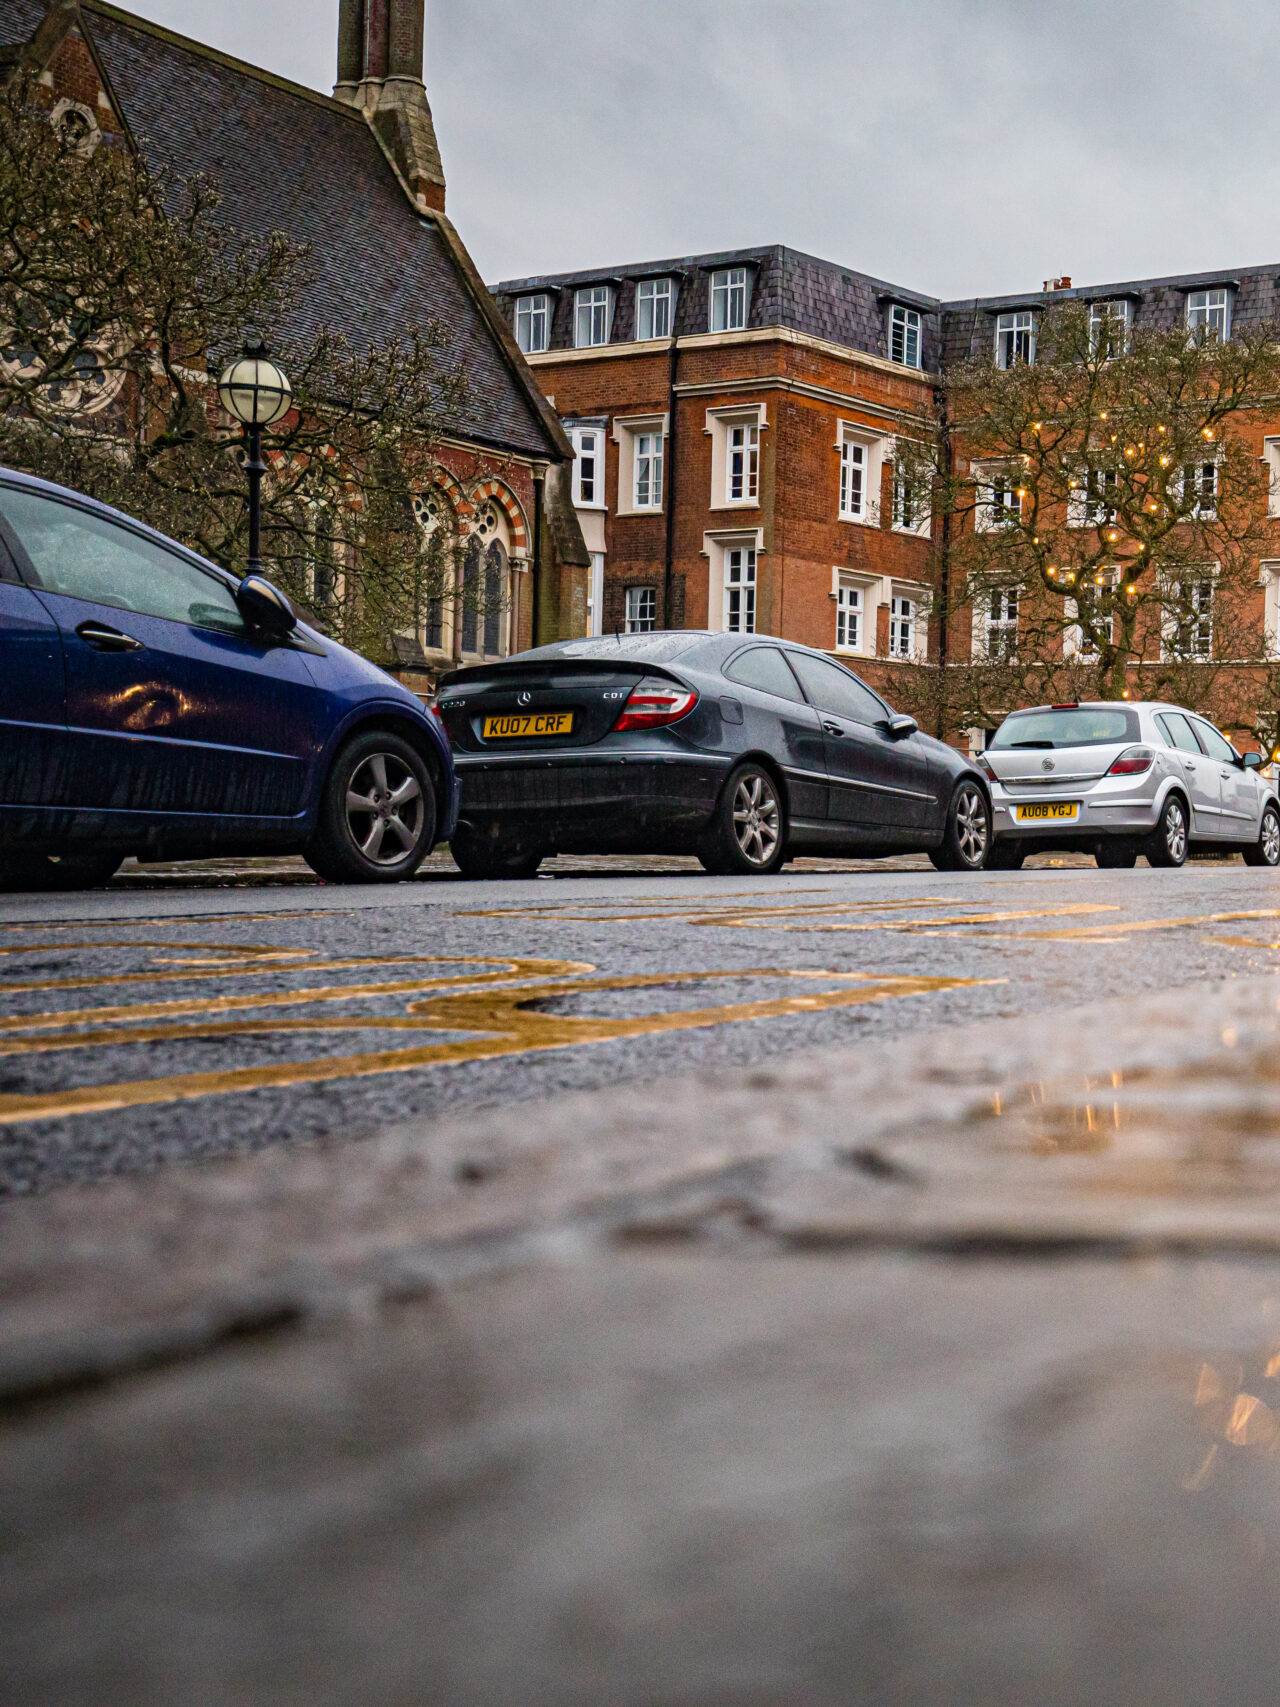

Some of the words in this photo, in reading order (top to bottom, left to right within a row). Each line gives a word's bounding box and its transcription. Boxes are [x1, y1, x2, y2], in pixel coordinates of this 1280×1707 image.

[489, 717, 530, 735] KU07
[535, 715, 567, 732] CRF
[1021, 806, 1048, 818] AU08
[1051, 805, 1073, 816] YGJ
